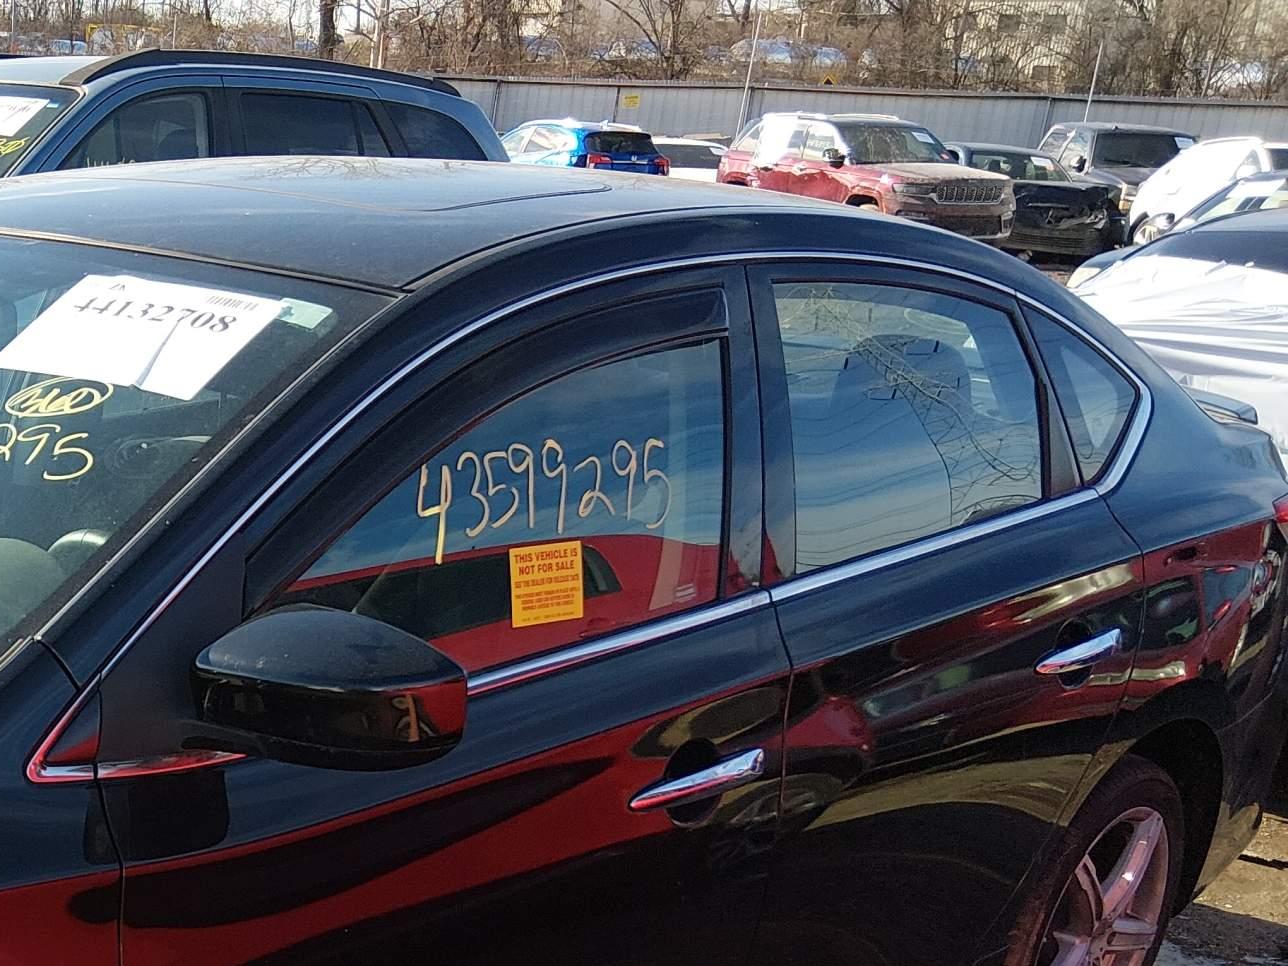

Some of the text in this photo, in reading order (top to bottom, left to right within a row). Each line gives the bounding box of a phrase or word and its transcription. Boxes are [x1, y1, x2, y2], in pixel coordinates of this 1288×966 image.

[73, 296, 237, 333] 44132708
[416, 438, 673, 566] 43599295
[514, 547, 578, 564] THIS VEHICLE IS
[518, 559, 575, 577] NOT FOR SALE
